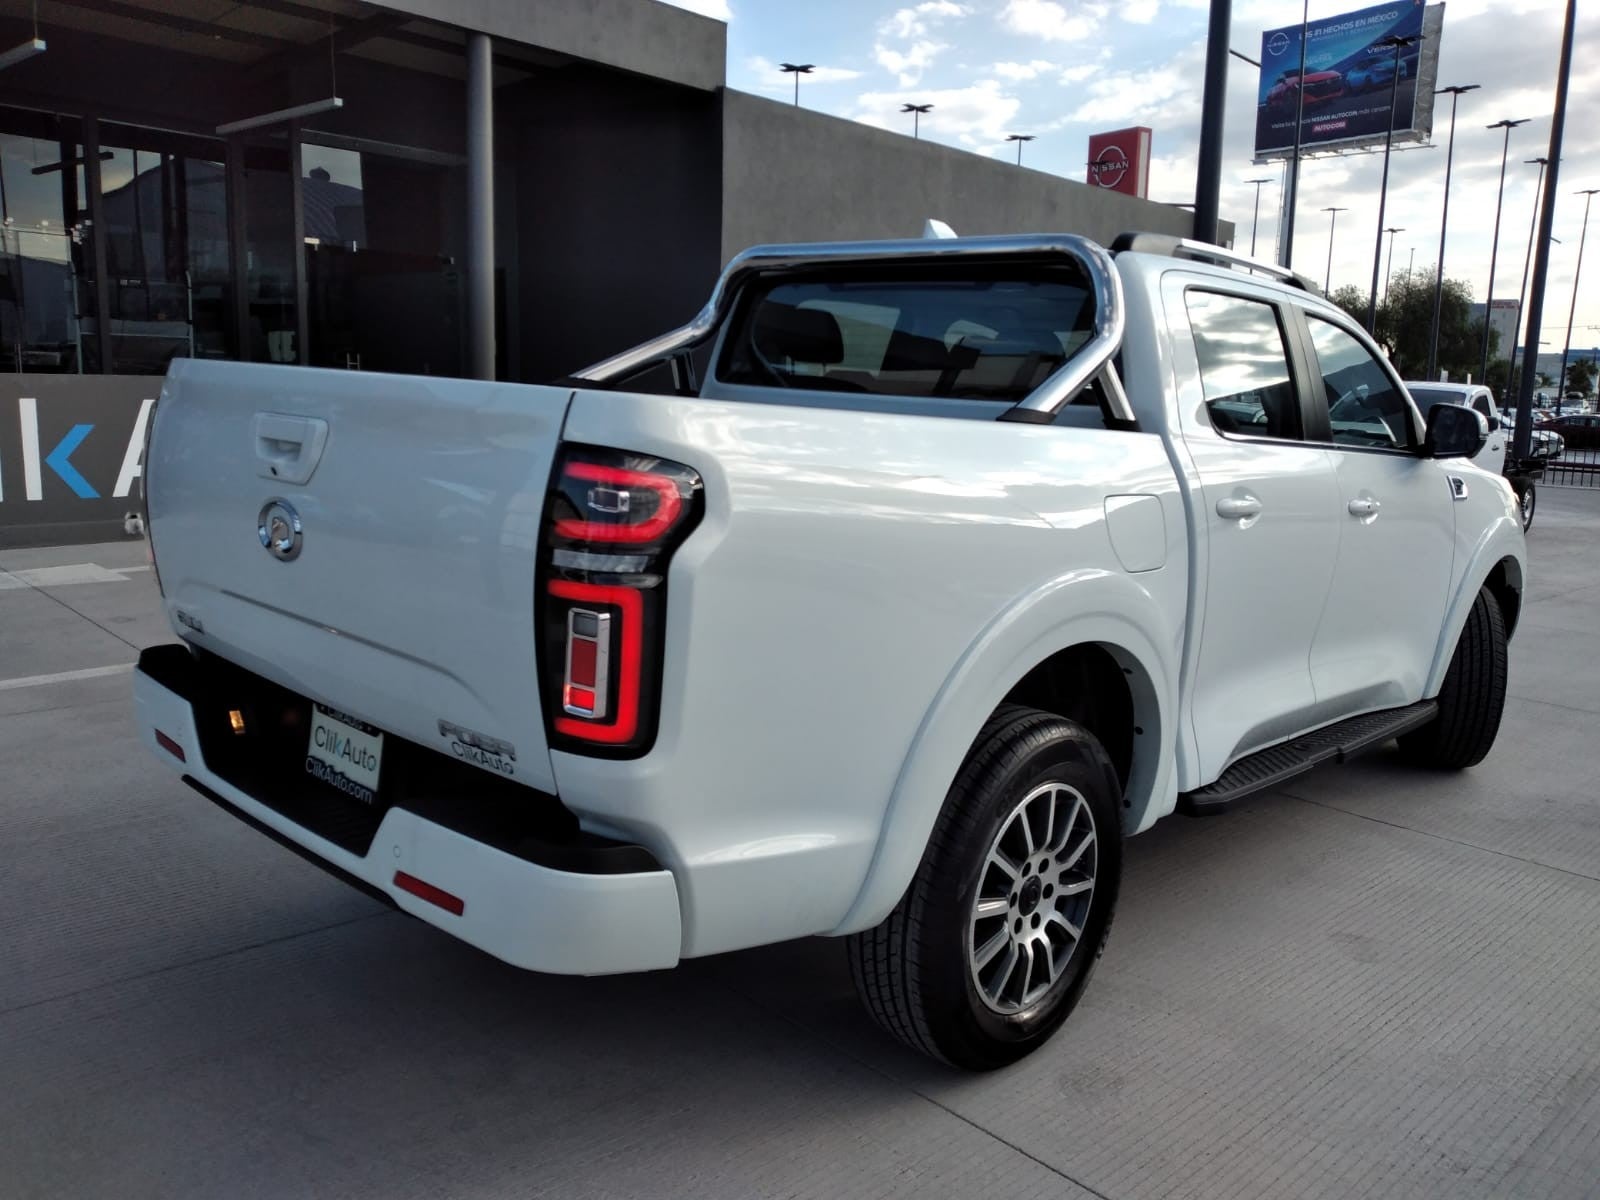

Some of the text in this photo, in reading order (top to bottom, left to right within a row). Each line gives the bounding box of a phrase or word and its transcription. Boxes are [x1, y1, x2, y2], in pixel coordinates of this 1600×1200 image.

[1322, 21, 1354, 34] HECHOS
[1355, 18, 1366, 28] EN
[314, 725, 377, 772] ClikAuto
[452, 741, 514, 775] ClikAuto
[305, 757, 372, 805] ClikAuto.com
